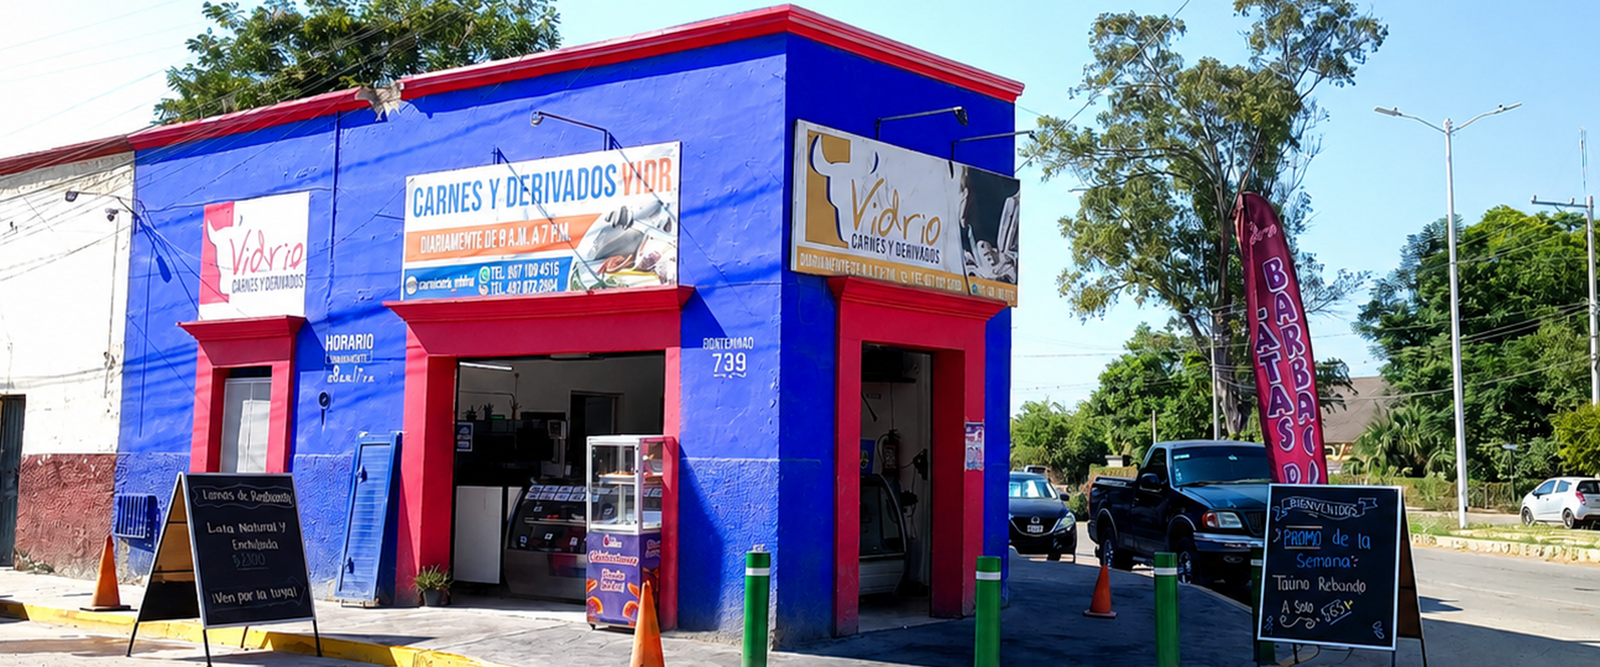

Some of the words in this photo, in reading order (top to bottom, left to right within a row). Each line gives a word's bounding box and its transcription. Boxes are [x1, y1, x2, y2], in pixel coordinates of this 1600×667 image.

[413, 178, 483, 218] CARNES
[489, 177, 501, 210] Y
[506, 163, 617, 208] DERIVADOS
[851, 177, 942, 247] Vidrio
[484, 229, 497, 249] DE
[531, 225, 540, 245] A
[541, 224, 549, 244] 7
[229, 228, 304, 276] Vidrio
[888, 240, 895, 257] Y
[325, 333, 374, 351] HORARIO
[712, 352, 747, 373] 739
[1283, 529, 1322, 547] PROMO
[1332, 528, 1349, 547] de
[1358, 533, 1371, 550] la
[237, 591, 253, 605] por
[256, 589, 268, 600] la
[1281, 600, 1291, 615] A
[1295, 600, 1314, 615] Solo
